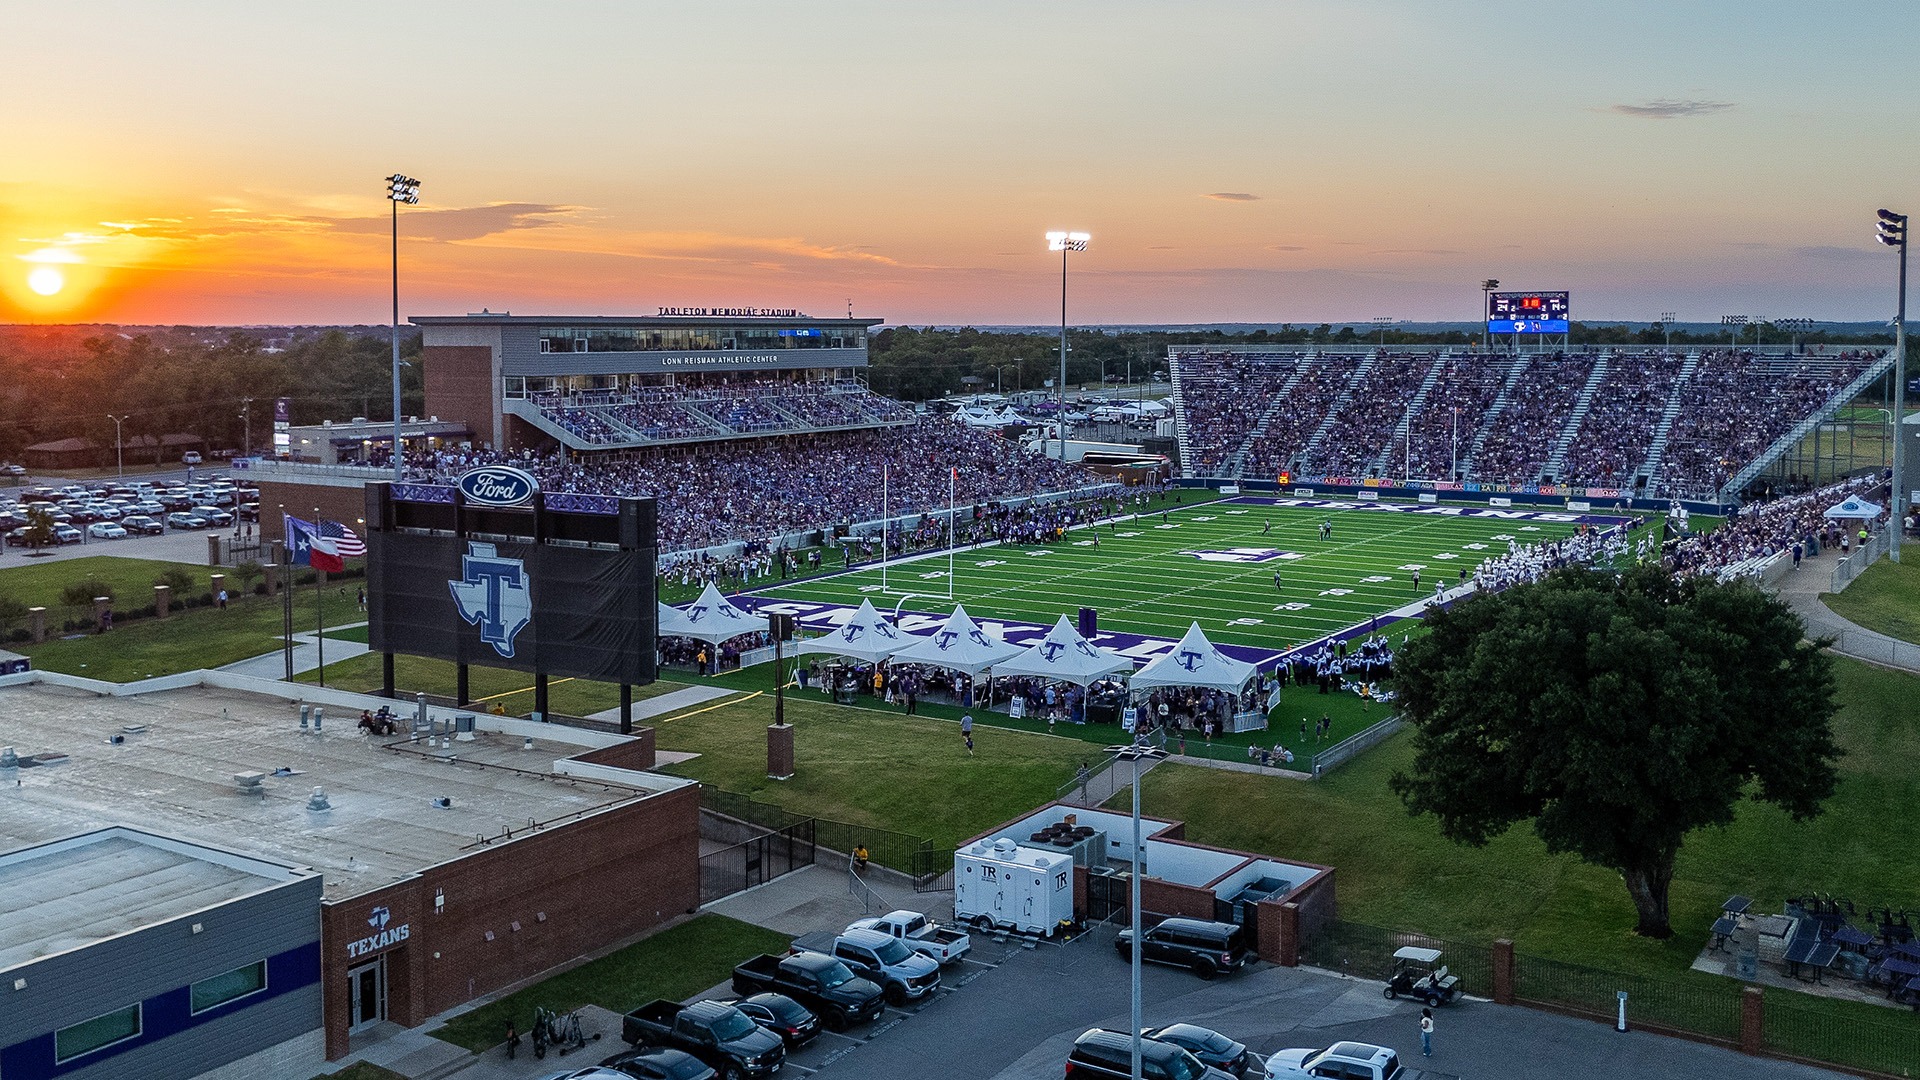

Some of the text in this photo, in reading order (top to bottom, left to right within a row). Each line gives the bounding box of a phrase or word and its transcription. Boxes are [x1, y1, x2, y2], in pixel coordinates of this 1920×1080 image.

[657, 307, 707, 316] TARLETON
[760, 308, 796, 317] STADIUM
[752, 355, 778, 363] CENTER
[472, 473, 517, 500] Ford
[1272, 499, 1579, 522] TEXANS
[981, 865, 997, 878] TR
[1055, 871, 1067, 889] TR
[347, 923, 410, 958] TEXANS
